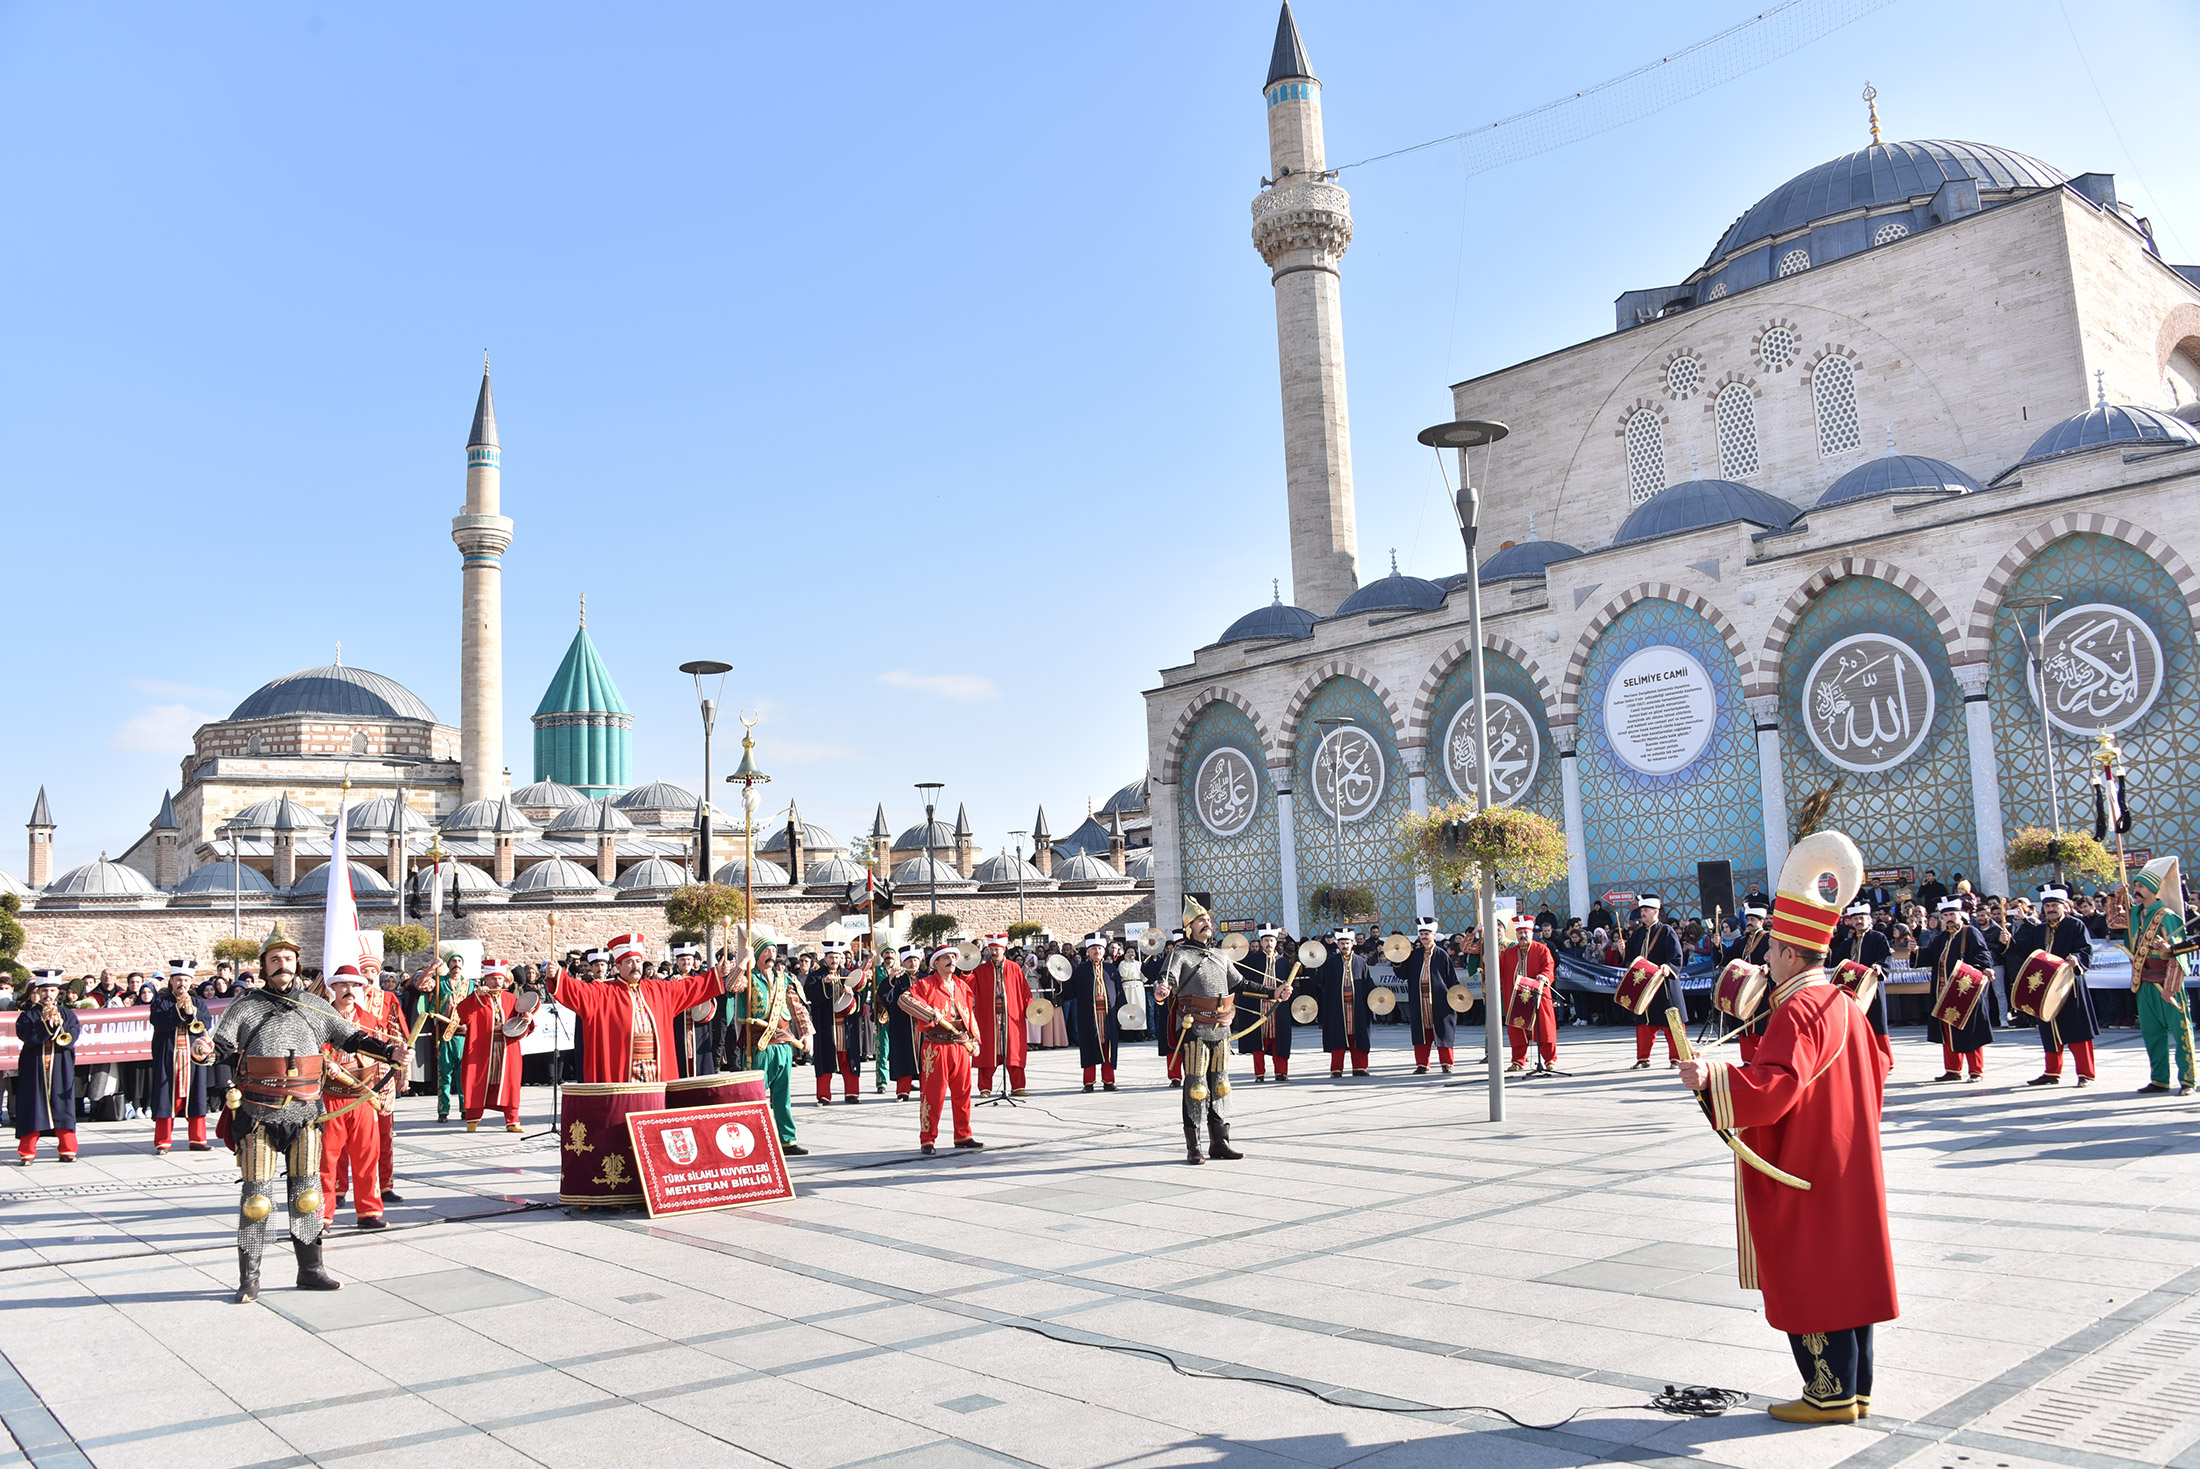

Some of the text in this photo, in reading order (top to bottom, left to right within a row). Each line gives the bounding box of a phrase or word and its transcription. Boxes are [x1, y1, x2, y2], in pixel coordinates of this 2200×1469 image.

[1623, 666, 1688, 688] SELİMİYE CAMİİ
[662, 1161, 769, 1184] TÜRK SİLAHLI KUVVETLERİ
[665, 1173, 773, 1196] MEHTERAN BİRLİĞİ
